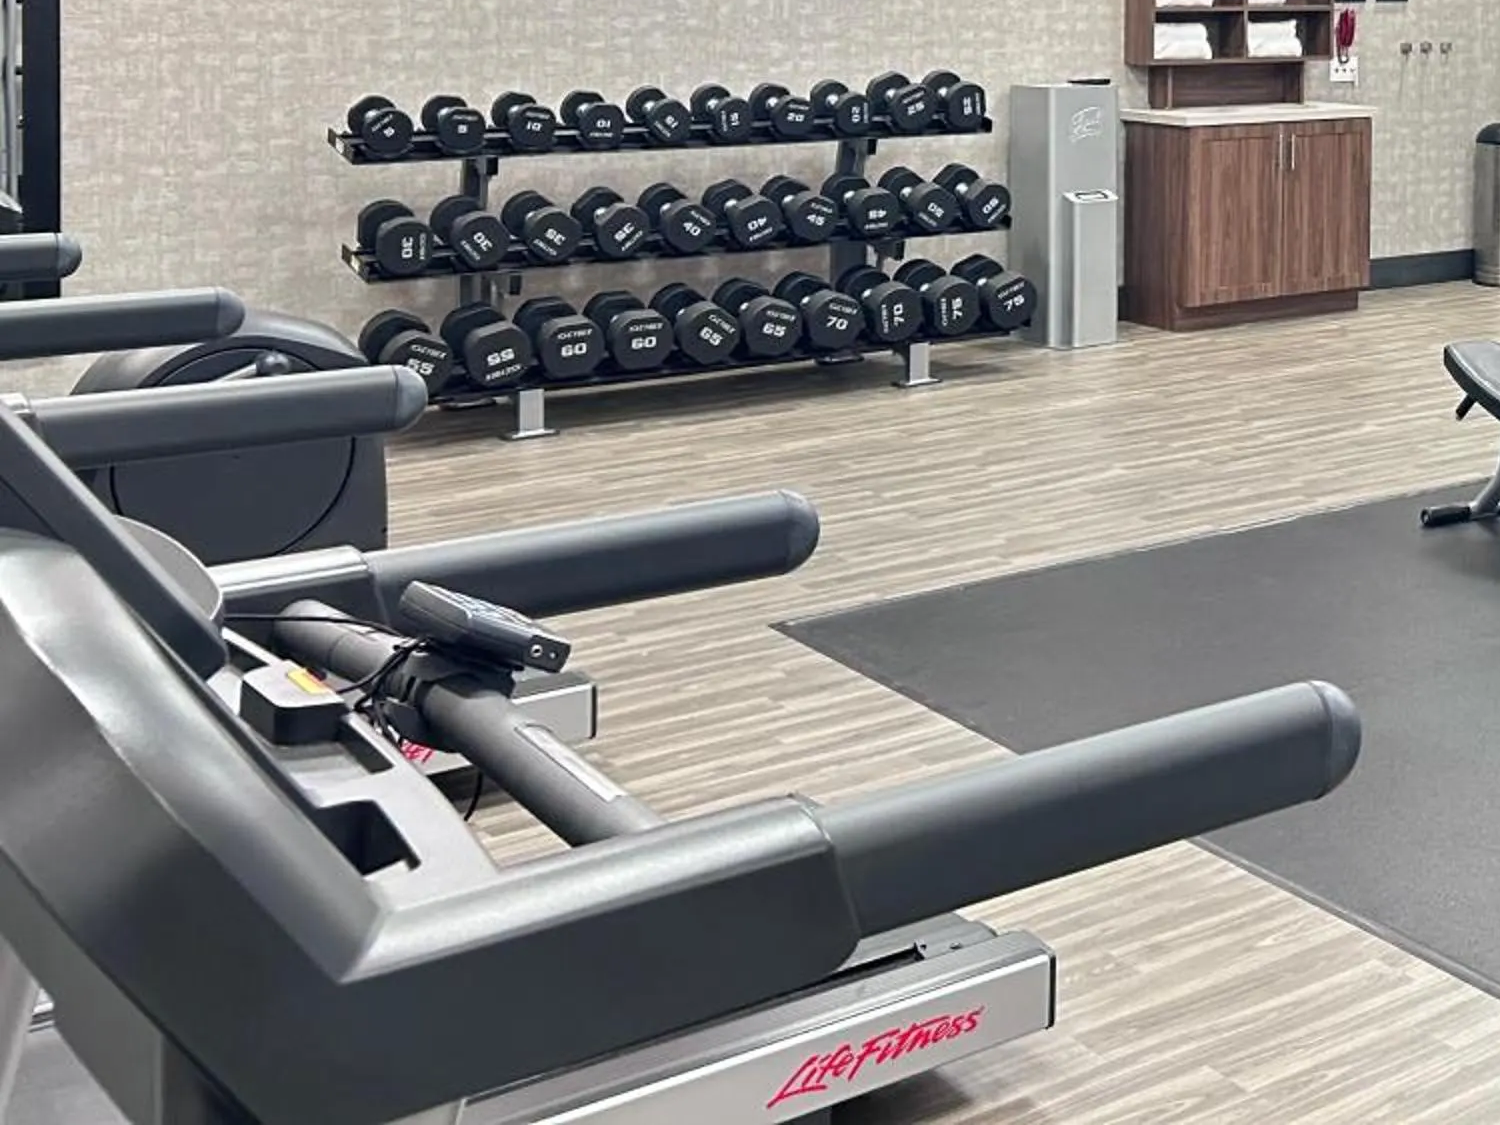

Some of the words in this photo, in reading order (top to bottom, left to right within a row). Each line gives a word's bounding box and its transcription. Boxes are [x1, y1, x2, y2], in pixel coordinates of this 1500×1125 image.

[683, 222, 701, 236] 40
[747, 216, 767, 231] 40
[401, 236, 413, 258] 30
[473, 232, 493, 251] 30
[952, 296, 963, 320] 75
[1003, 294, 1025, 312] 75
[826, 316, 848, 330] 70
[893, 303, 905, 326] 70
[699, 326, 723, 347] 65
[762, 322, 786, 338] 65
[560, 342, 588, 357] 60
[631, 336, 657, 350] 60
[486, 348, 515, 366] 55
